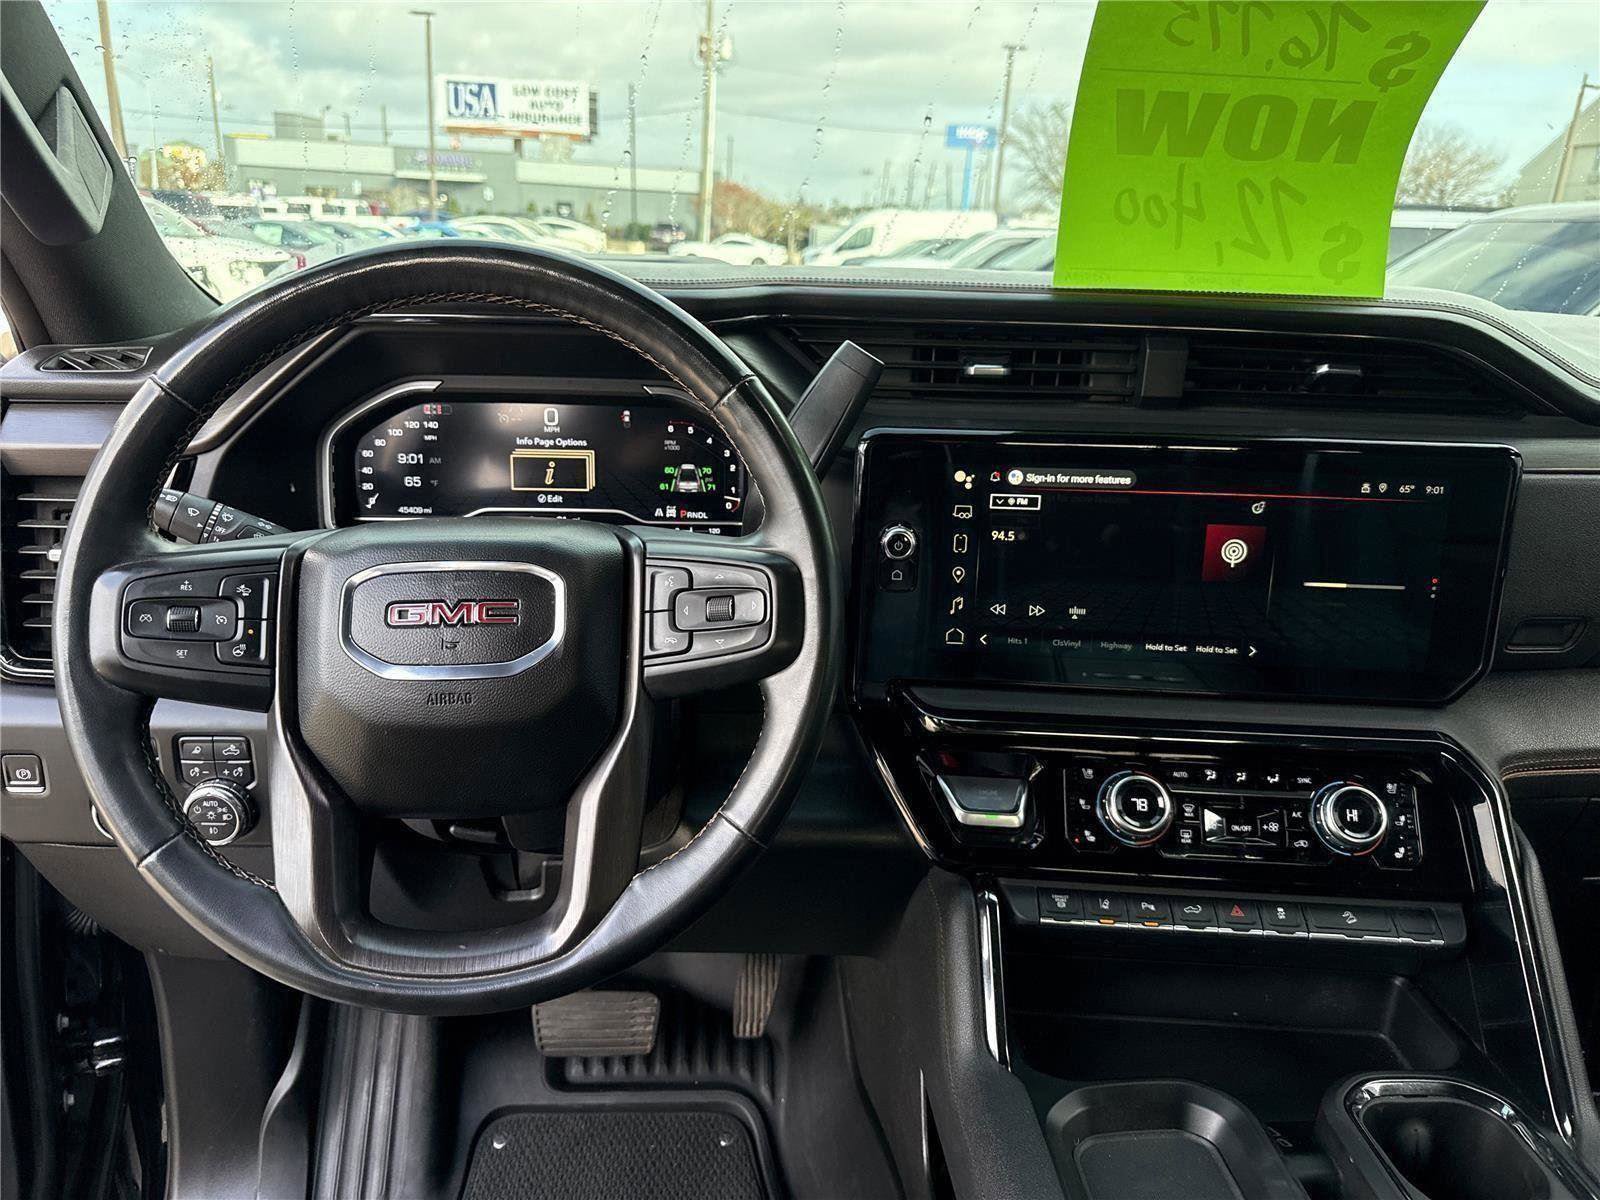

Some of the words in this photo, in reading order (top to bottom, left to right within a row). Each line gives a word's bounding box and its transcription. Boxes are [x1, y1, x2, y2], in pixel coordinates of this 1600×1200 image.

[448, 82, 498, 118] USA
[404, 420, 420, 429] 120
[423, 420, 439, 429] 140
[387, 428, 403, 437] 100
[374, 438, 387, 447] 80
[516, 437, 533, 446] Info
[534, 437, 554, 448] Page
[555, 437, 587, 448] Options
[706, 437, 713, 445] 4
[361, 450, 374, 458] 60
[723, 449, 731, 457] 3
[397, 453, 424, 465] 9:01
[429, 457, 442, 465] AM
[361, 467, 373, 475] 40
[730, 464, 736, 472] 2
[404, 476, 422, 487] 65
[1026, 473, 1056, 485] Sign-in
[1057, 473, 1070, 484] for
[1071, 475, 1094, 484] more
[1095, 474, 1131, 485] features
[361, 482, 374, 490] 20
[707, 483, 716, 491] 71
[1425, 485, 1445, 495] 9:01
[547, 495, 563, 503] Edit
[1016, 497, 1028, 506] FM
[725, 502, 732, 510] 0
[215, 525, 227, 534] OFF
[991, 530, 1016, 542] 94.5
[386, 600, 521, 627] GMC
[1007, 636, 1022, 645] Hits
[1100, 640, 1133, 651] Highway
[1145, 643, 1165, 652] Hold
[1174, 644, 1188, 652] Set
[1195, 645, 1215, 654] Hold
[1224, 646, 1238, 655] Set
[426, 692, 474, 706] AIRBAG
[1346, 809, 1359, 822] HI
